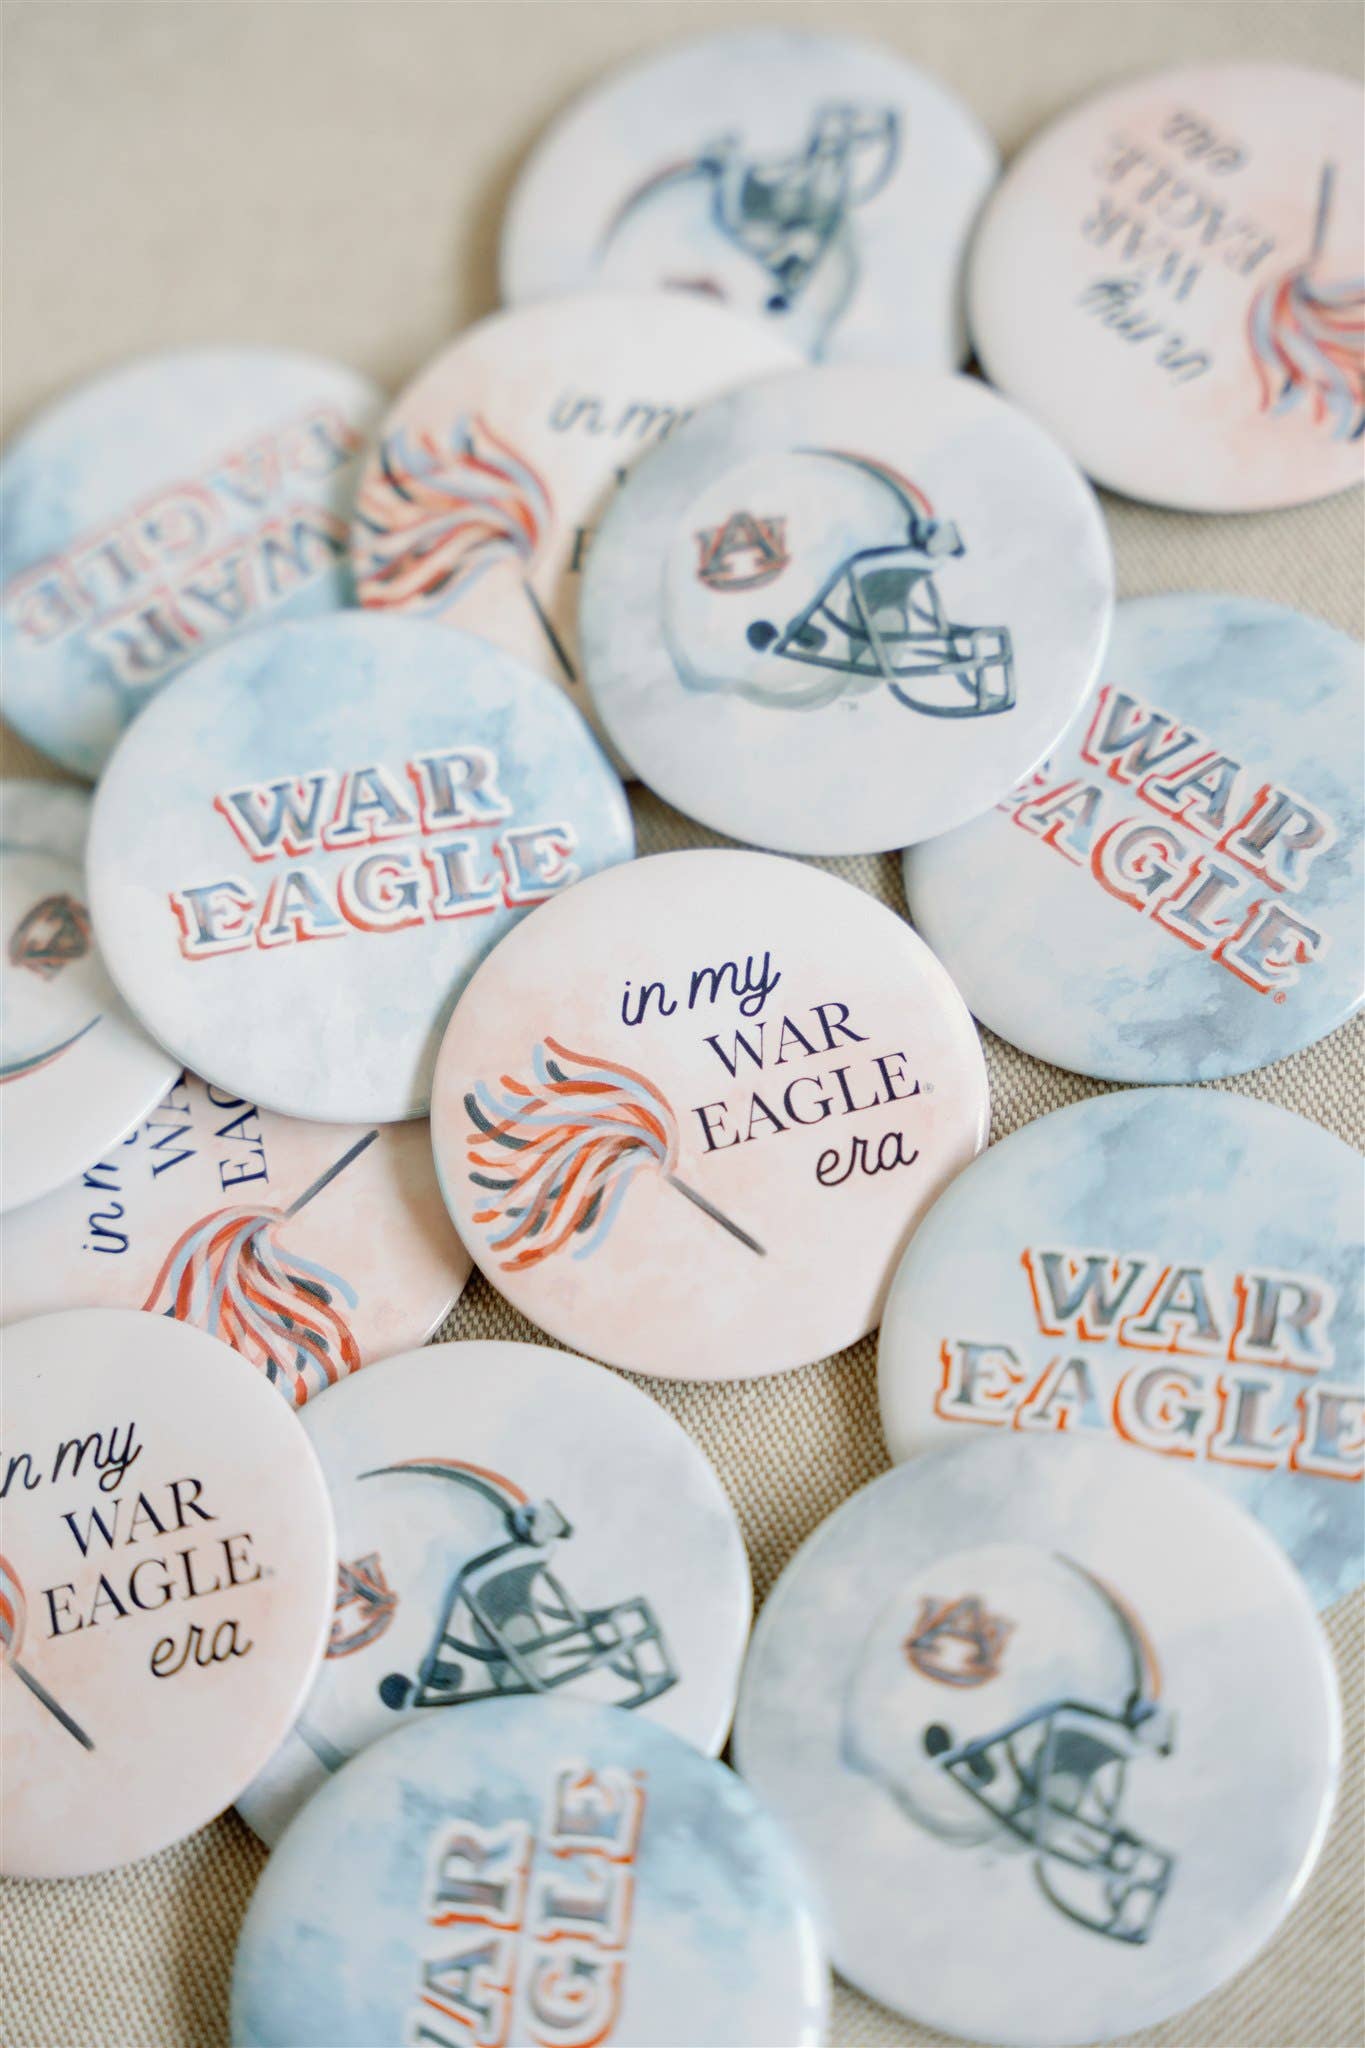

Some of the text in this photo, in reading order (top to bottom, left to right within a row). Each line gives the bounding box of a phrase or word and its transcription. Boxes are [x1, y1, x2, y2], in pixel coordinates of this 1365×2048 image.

[612, 396, 698, 441] m
[212, 745, 514, 863] WAR
[1080, 684, 1336, 893] WAR
[169, 823, 580, 962] EAGLE
[996, 758, 1336, 1000] AGLE
[621, 950, 782, 1027] in my
[702, 1001, 872, 1079] WAR
[146, 1074, 198, 1180] WA
[690, 1051, 921, 1155] EAGLE
[815, 1131, 920, 1187] era
[82, 1201, 130, 1254] in
[1020, 1247, 1334, 1375] WAR
[0, 1421, 143, 1499] n my
[934, 1337, 1365, 1483] EAGLE
[60, 1477, 219, 1558] WAR
[39, 1531, 264, 1640] EAGLE
[150, 1619, 254, 1679] era
[406, 1820, 536, 2048] AR
[526, 1758, 646, 2048] GLE
